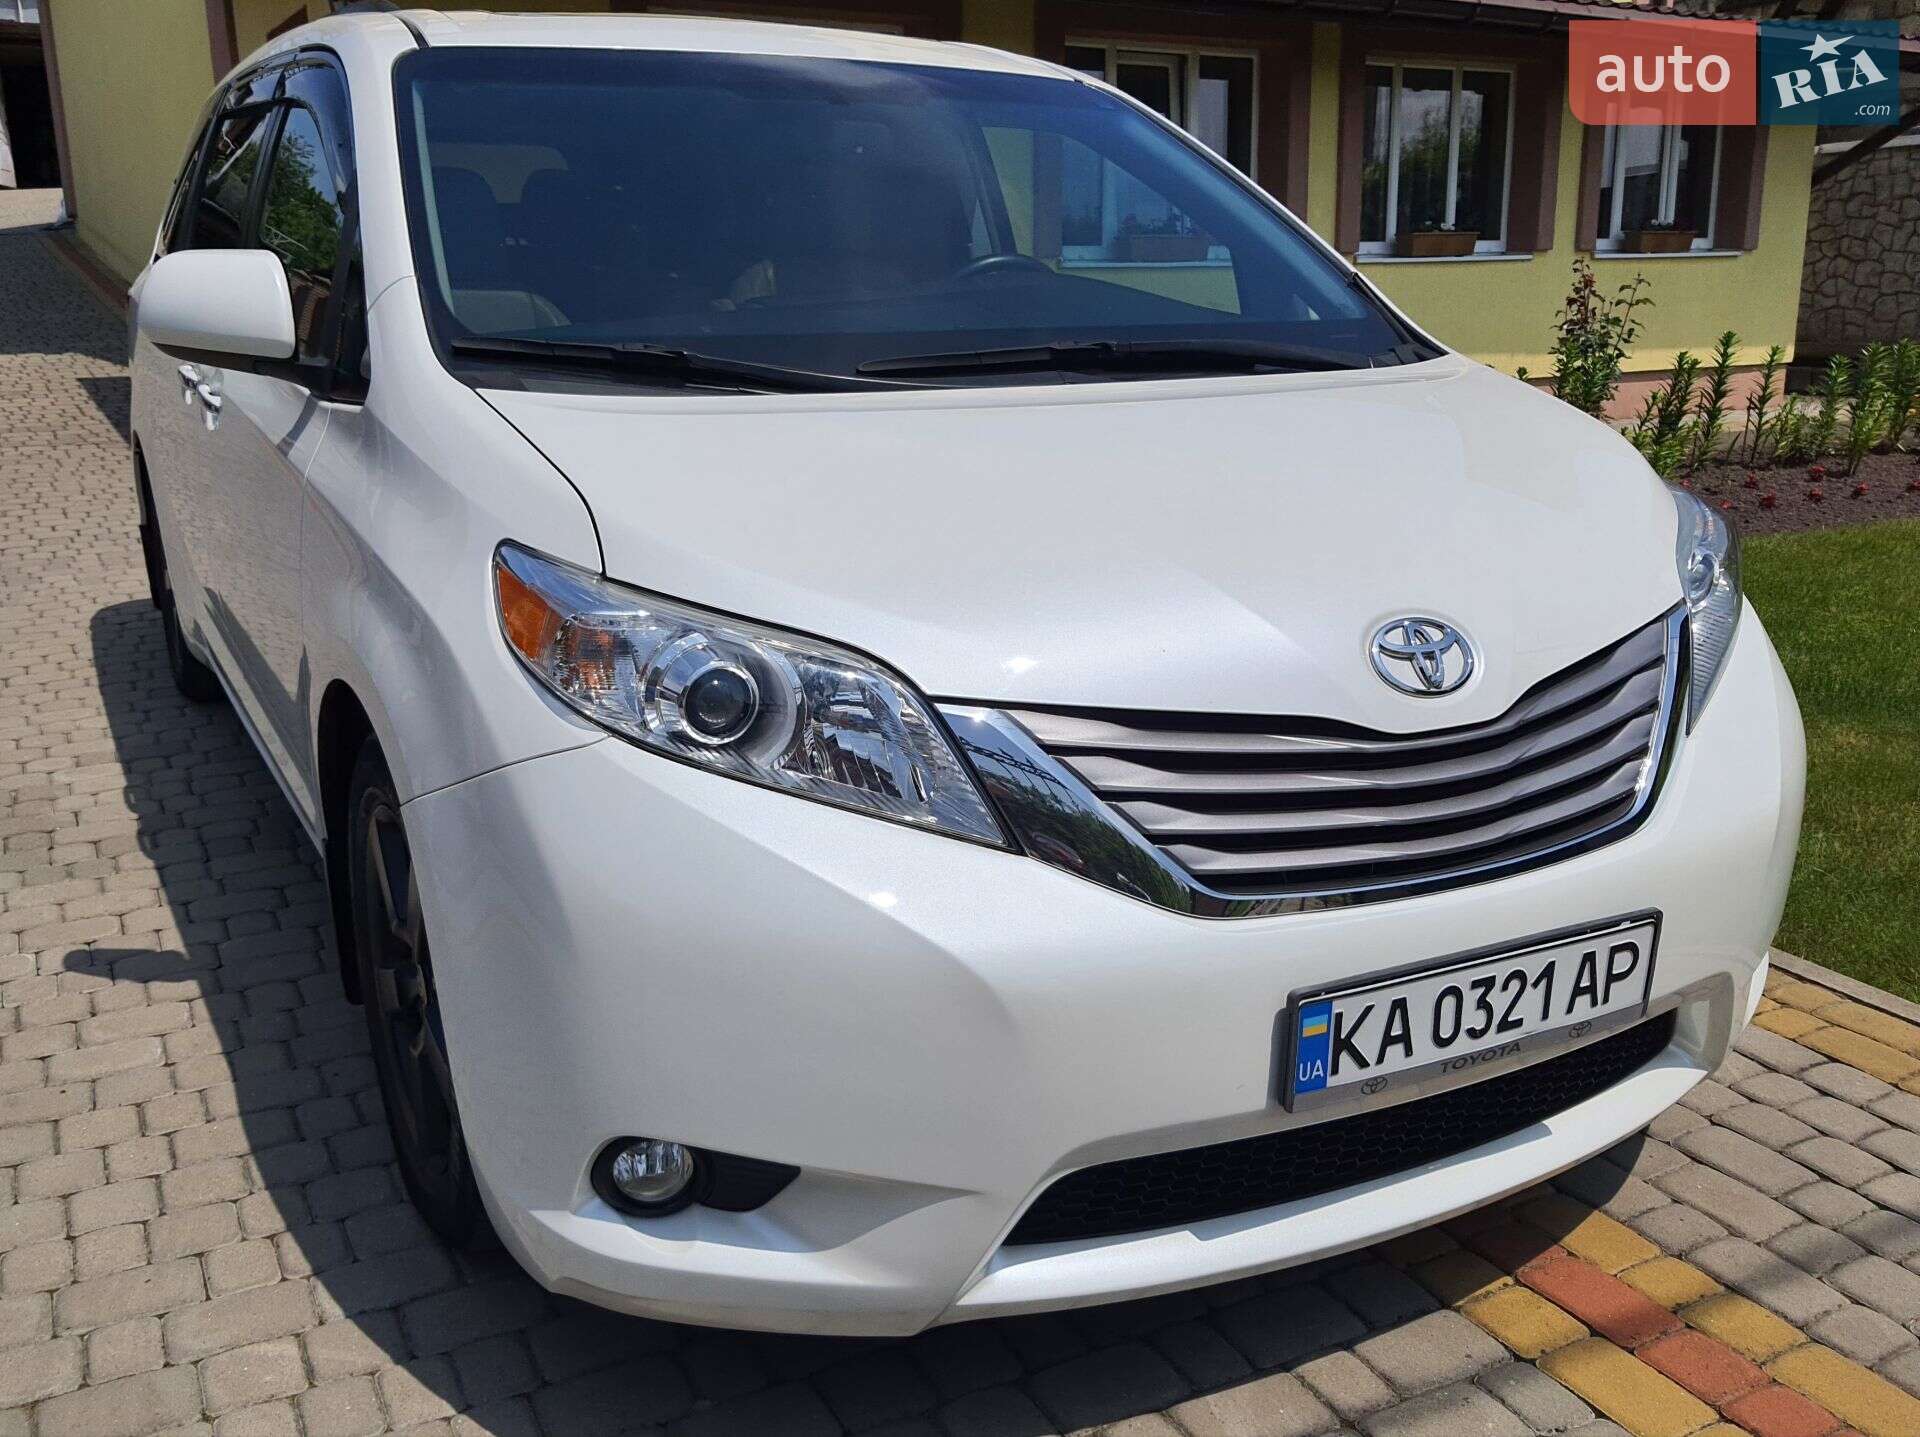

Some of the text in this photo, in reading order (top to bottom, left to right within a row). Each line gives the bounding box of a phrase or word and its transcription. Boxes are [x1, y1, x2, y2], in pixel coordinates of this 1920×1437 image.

[1330, 941, 1640, 1076] KA 0321 AP
[1300, 1059, 1325, 1081] UA
[1441, 1042, 1522, 1073] TOYOTA
